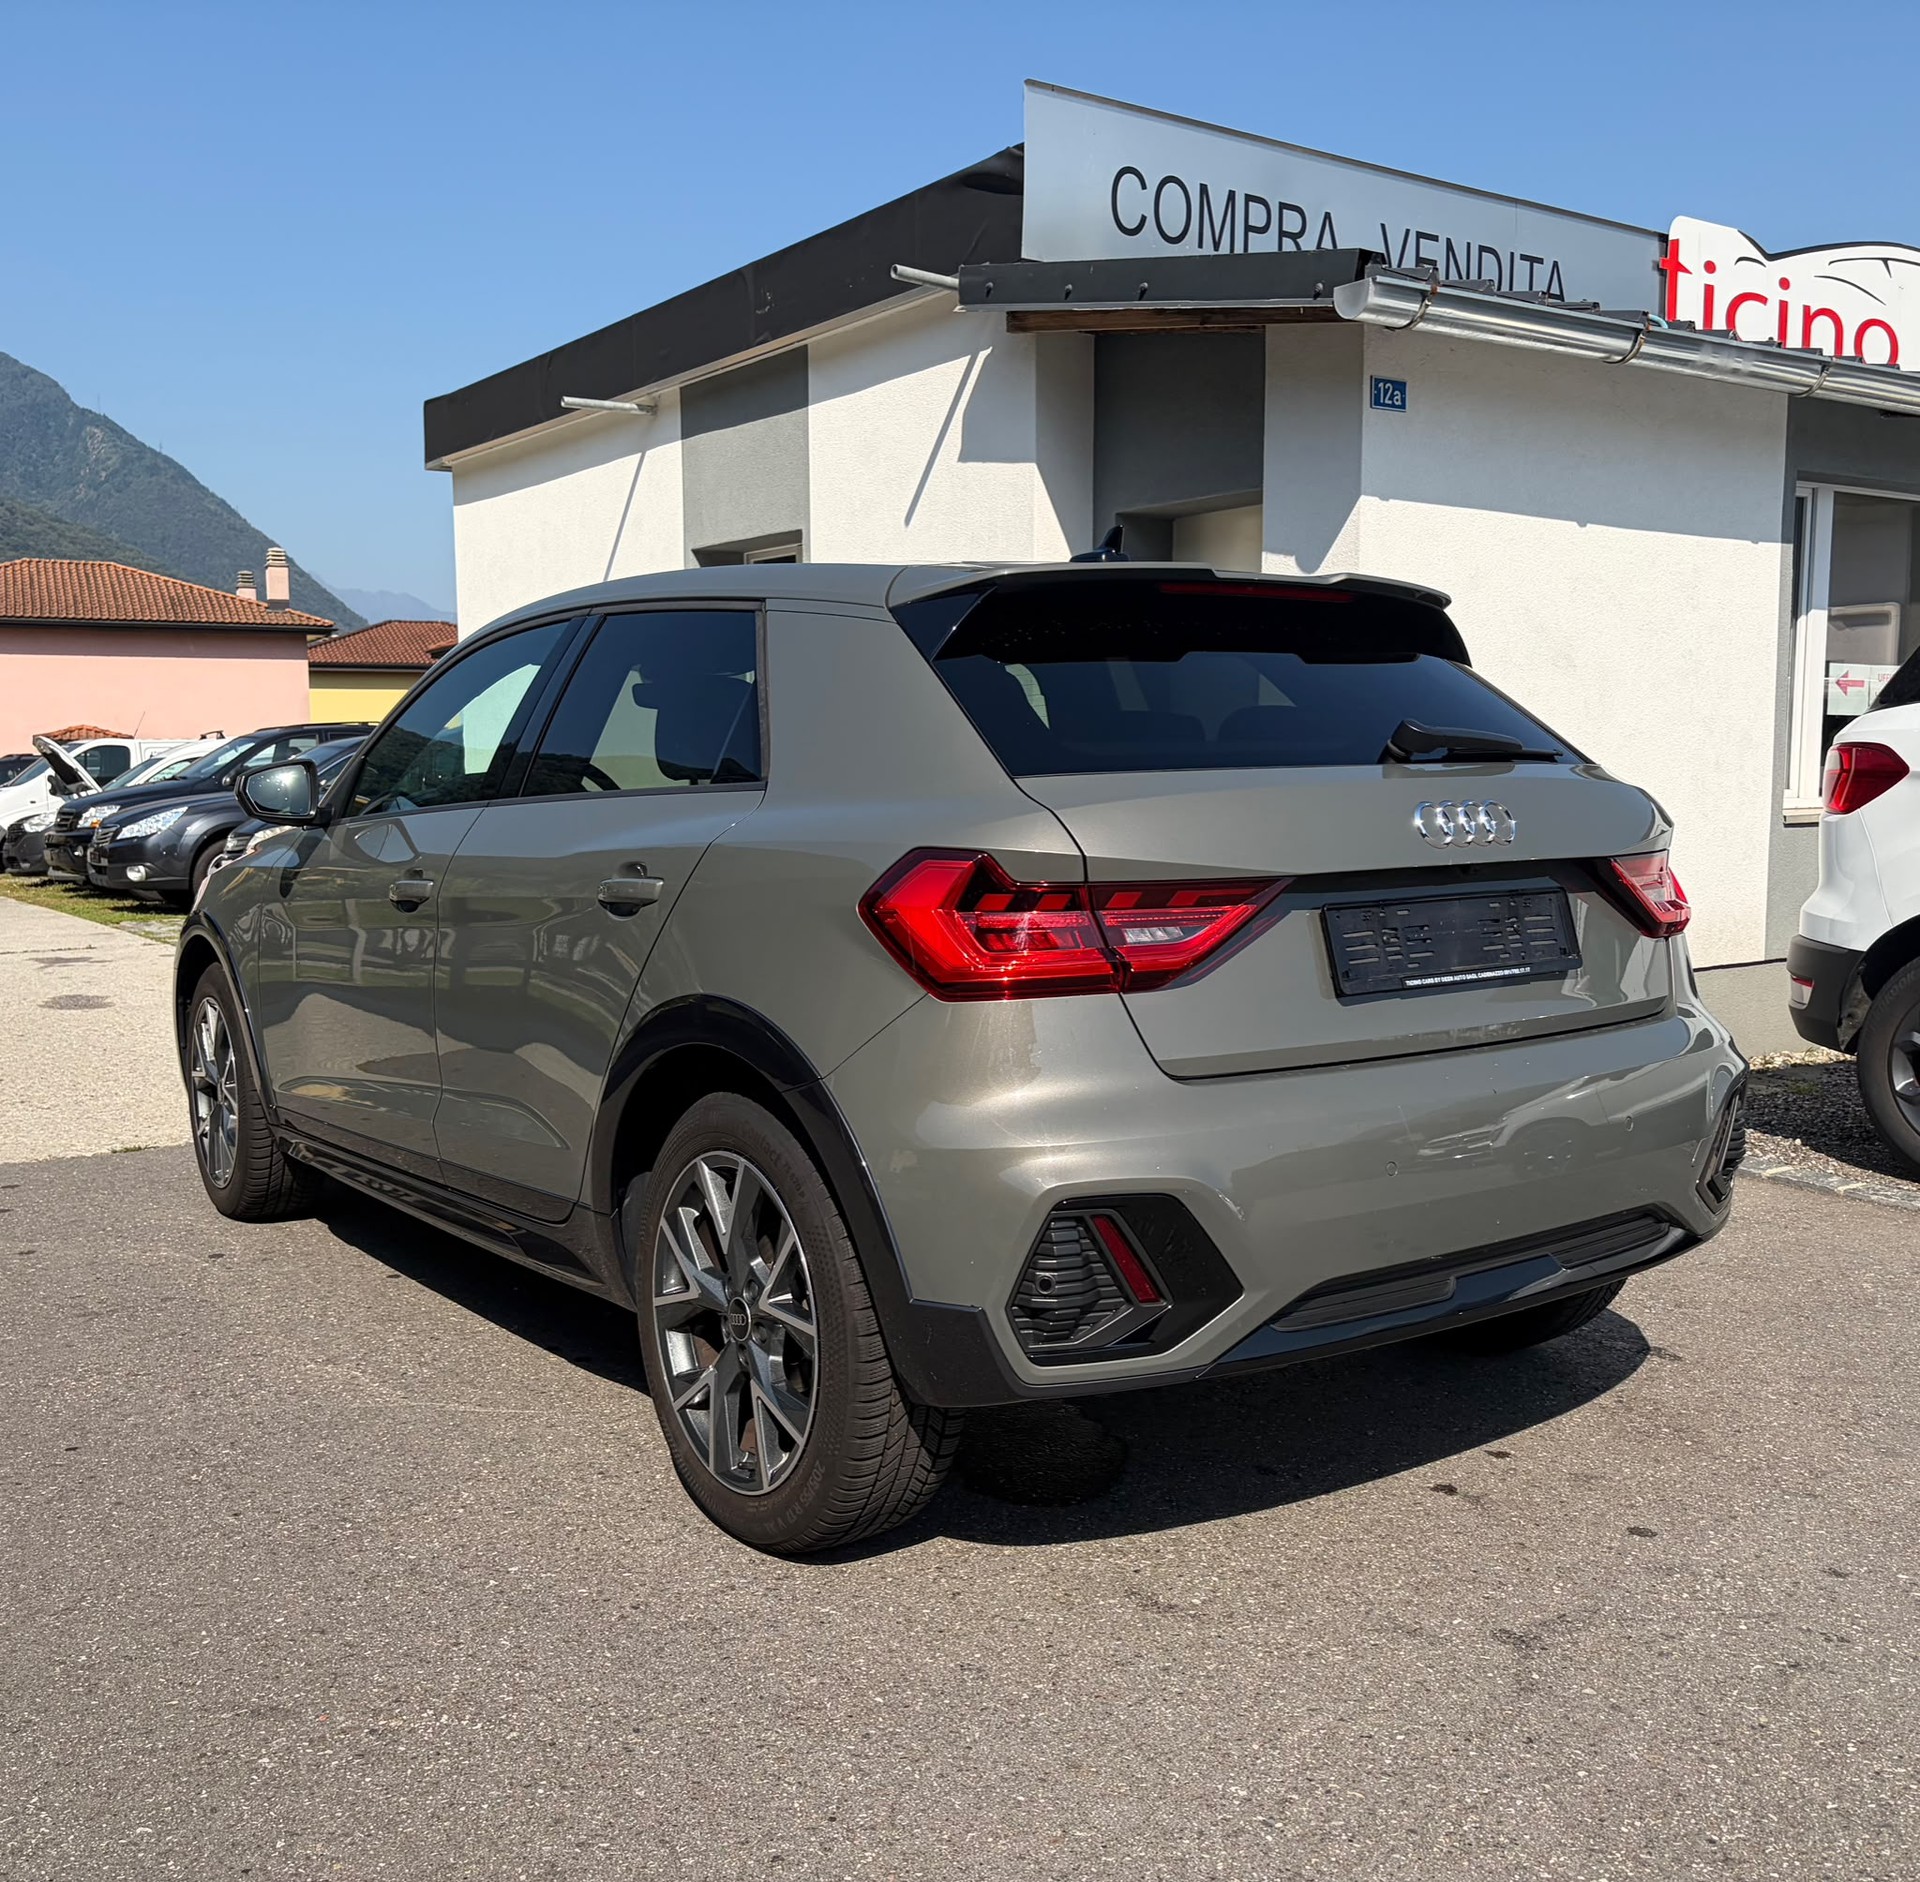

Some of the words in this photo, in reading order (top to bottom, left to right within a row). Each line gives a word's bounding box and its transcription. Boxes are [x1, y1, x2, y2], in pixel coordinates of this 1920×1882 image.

[1111, 165, 1338, 254] COMPRA
[1380, 222, 1565, 302] VENDITA
[1659, 238, 1900, 366] ticino
[1378, 382, 1402, 406] 12a
